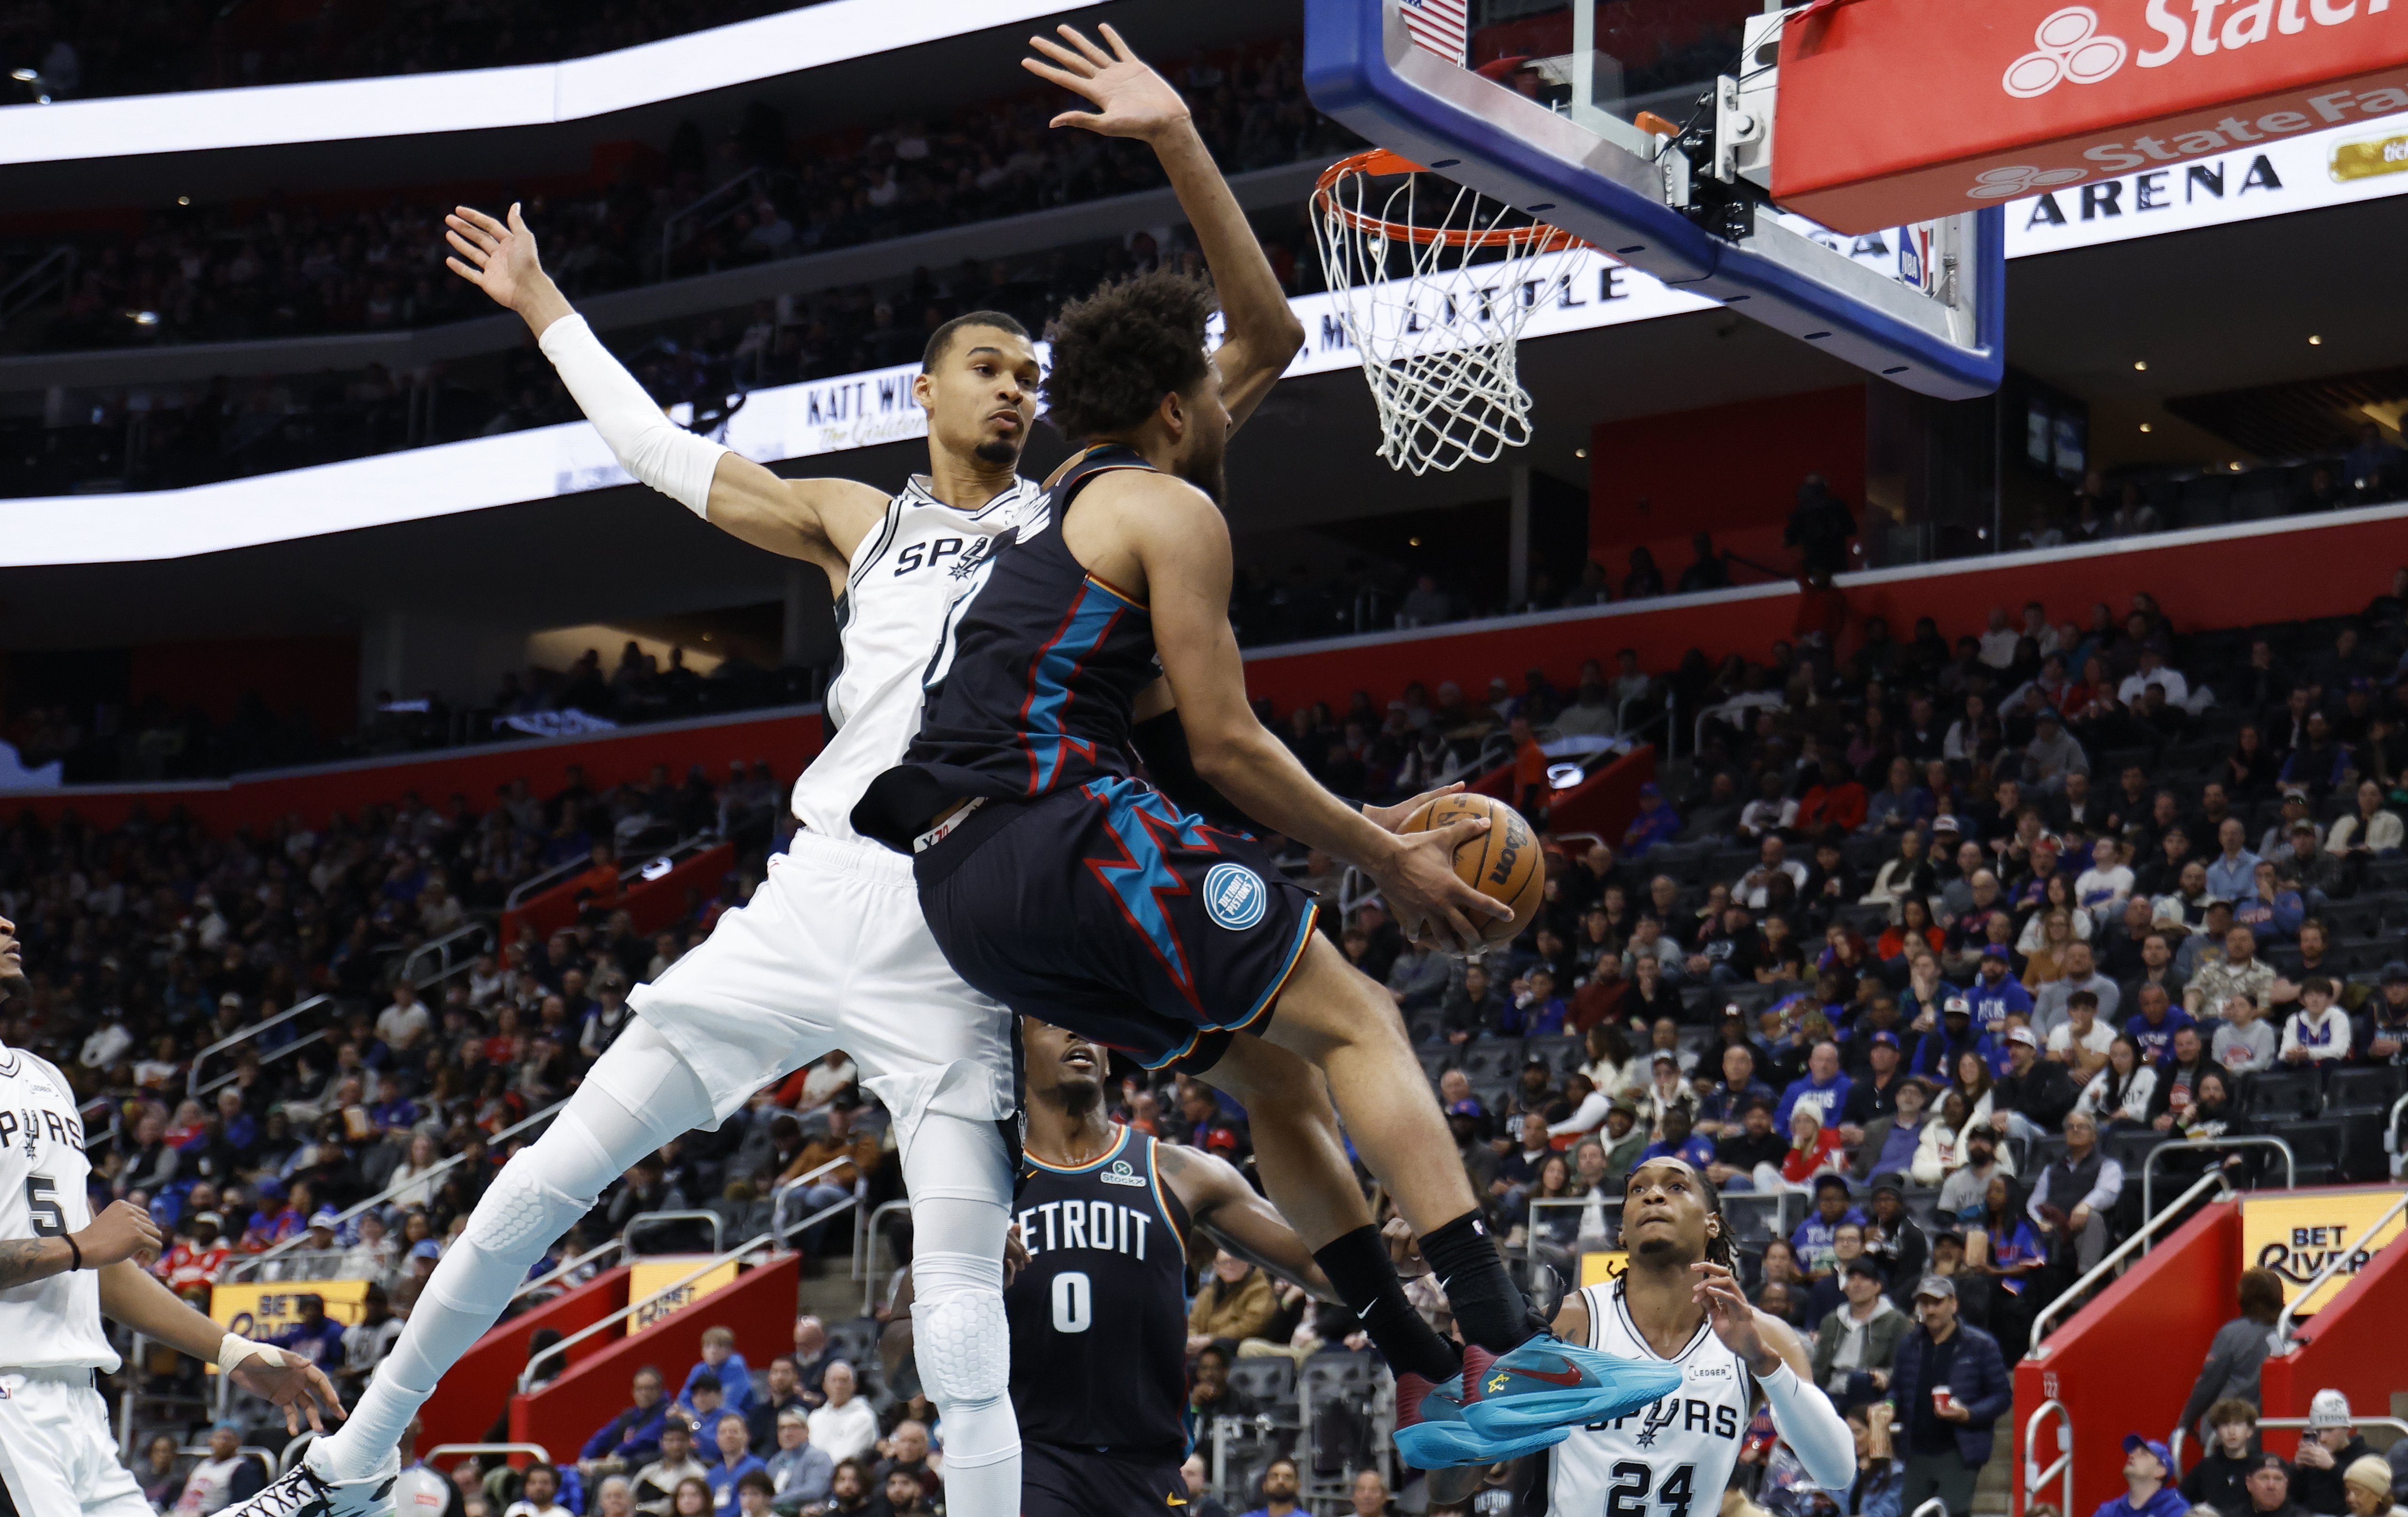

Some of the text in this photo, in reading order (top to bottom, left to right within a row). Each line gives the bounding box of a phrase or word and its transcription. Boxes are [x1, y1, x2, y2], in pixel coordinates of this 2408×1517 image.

[2083, 85, 2408, 171] State Fa
[1406, 265, 1630, 332] LITTLE
[2025, 154, 2283, 231] ARENA
[1901, 250, 1918, 279] NBA
[807, 382, 866, 425] KATT
[1218, 874, 1244, 908] DETROIT
[1225, 881, 1253, 916] PISTONS
[25, 1174, 71, 1238] 5
[1008, 1199, 1152, 1261] ETROIT
[2292, 1225, 2348, 1246] BET
[2258, 1242, 2383, 1283] RIVER
[1051, 1271, 1092, 1333] 0
[1694, 1368, 1726, 1377] LEDGER
[1604, 1459, 1697, 1517] 24
